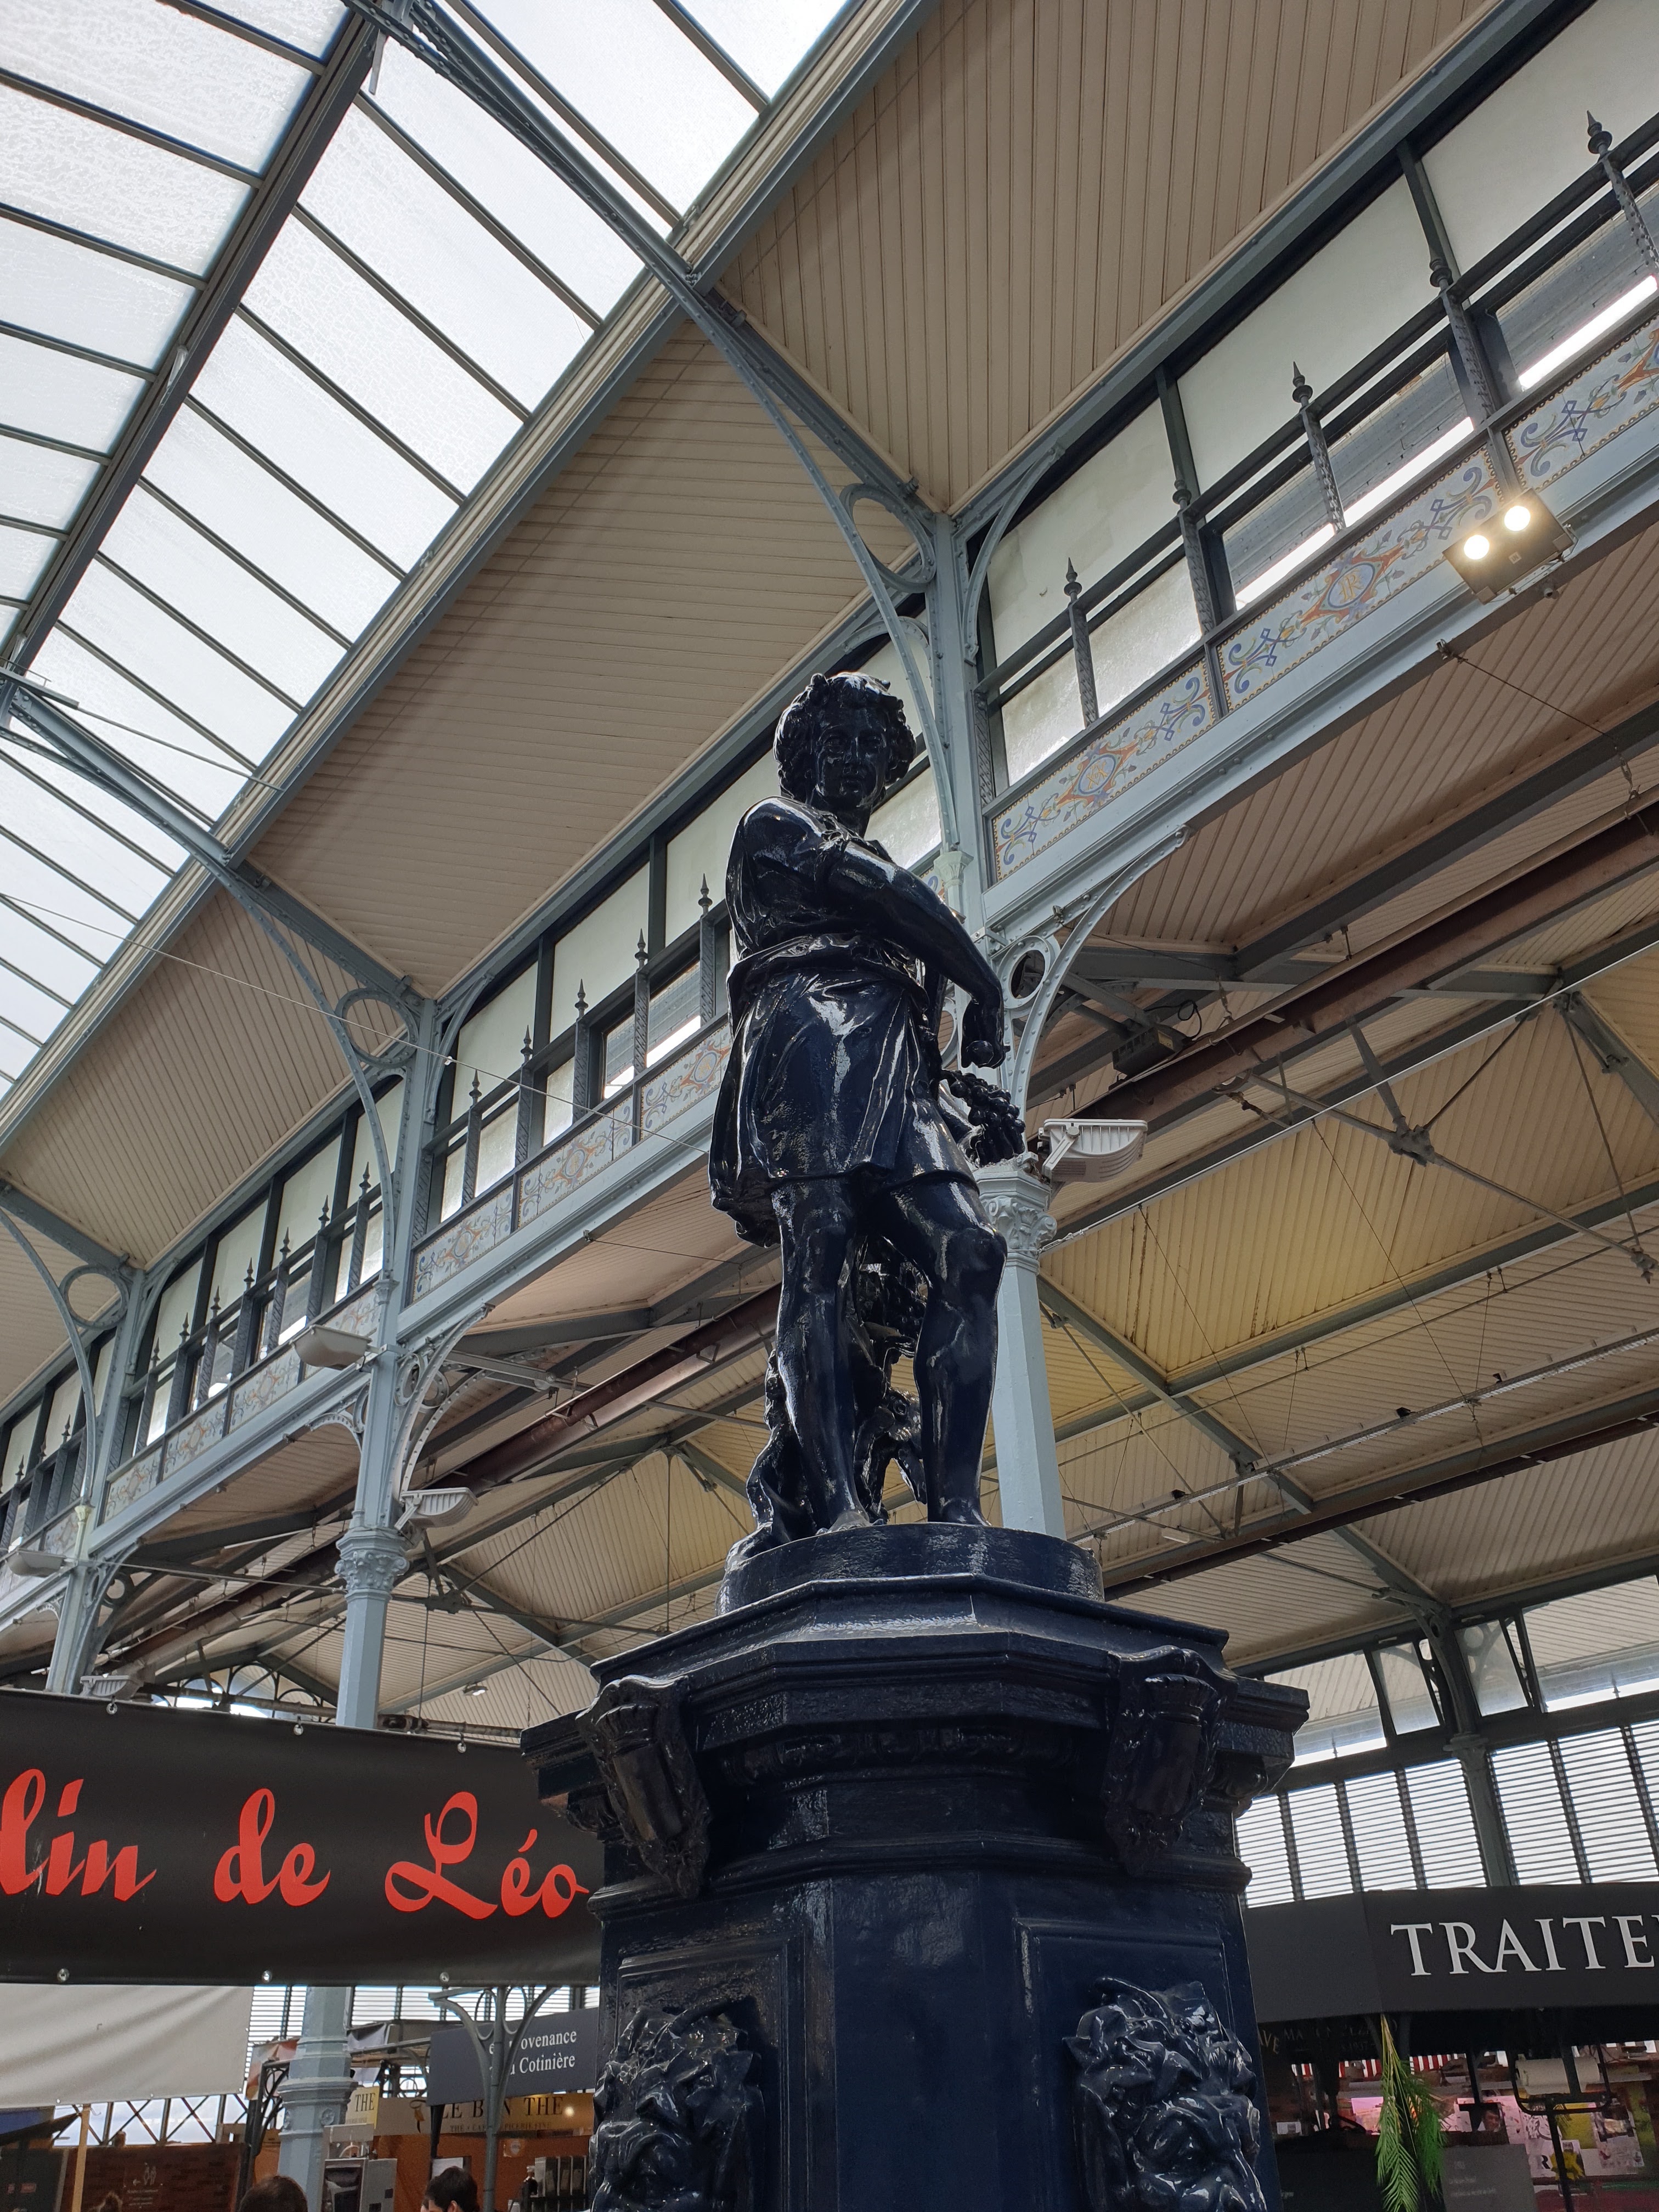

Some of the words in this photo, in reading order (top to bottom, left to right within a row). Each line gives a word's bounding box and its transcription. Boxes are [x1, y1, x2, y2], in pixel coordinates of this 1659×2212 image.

[0, 1769, 157, 1902] lin
[214, 1788, 331, 1906] de
[385, 1791, 589, 1920] Léo
[1390, 1915, 1659, 1976] TRAITE
[509, 2030, 577, 2050] ovenance
[519, 2052, 575, 2074] Cotinière
[355, 2092, 376, 2112] THE
[523, 2096, 564, 2116] THE
